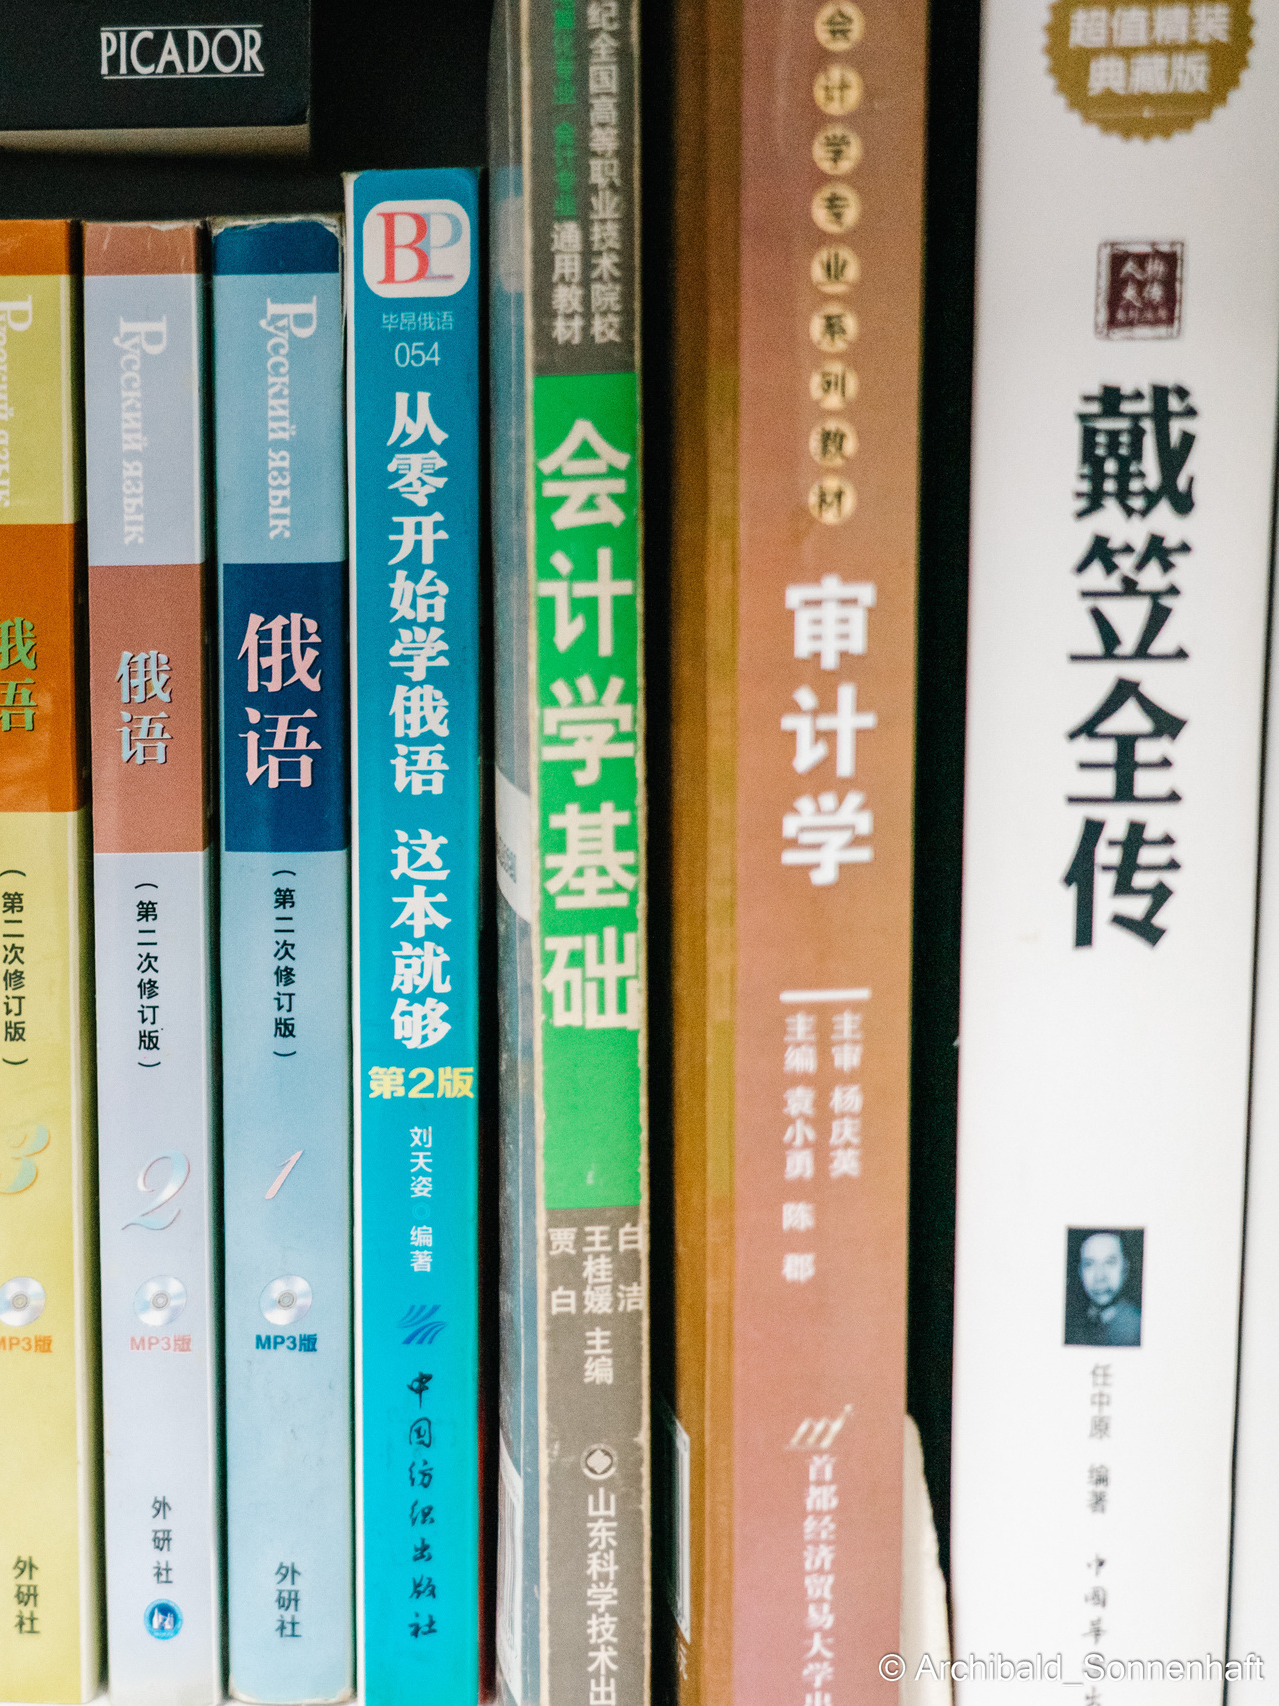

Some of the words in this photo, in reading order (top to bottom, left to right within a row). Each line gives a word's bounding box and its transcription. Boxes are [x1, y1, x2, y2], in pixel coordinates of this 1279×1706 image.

[100, 29, 263, 76] PICADOR
[113, 315, 168, 456] Русский
[260, 295, 318, 443] Русский
[395, 342, 441, 368] 054
[121, 458, 145, 546] язык
[267, 449, 292, 540] язык
[385, 390, 450, 796] 从零开始学俄语
[115, 651, 173, 766] 俄语
[238, 612, 322, 789] 俄语
[1061, 384, 1199, 950] 戴笠全传
[537, 418, 641, 1032] 会计学基础
[780, 574, 877, 886] 审计学
[390, 828, 452, 1049] 这本就够
[368, 1066, 475, 1099] 第2版
[121, 1149, 191, 1231] 2
[264, 1149, 305, 1201] 1
[409, 1125, 433, 1198] 刘天姿
[409, 1225, 433, 1273] 编著
[130, 1334, 192, 1353] MP3版
[255, 1333, 318, 1353] MP3版
[583, 1327, 614, 1385] 主编
[151, 1496, 173, 1586] 外研社
[406, 1371, 438, 1640] 中国纺织出版社
[12, 1555, 41, 1636] 外研社
[274, 1561, 302, 1639] 外研社
